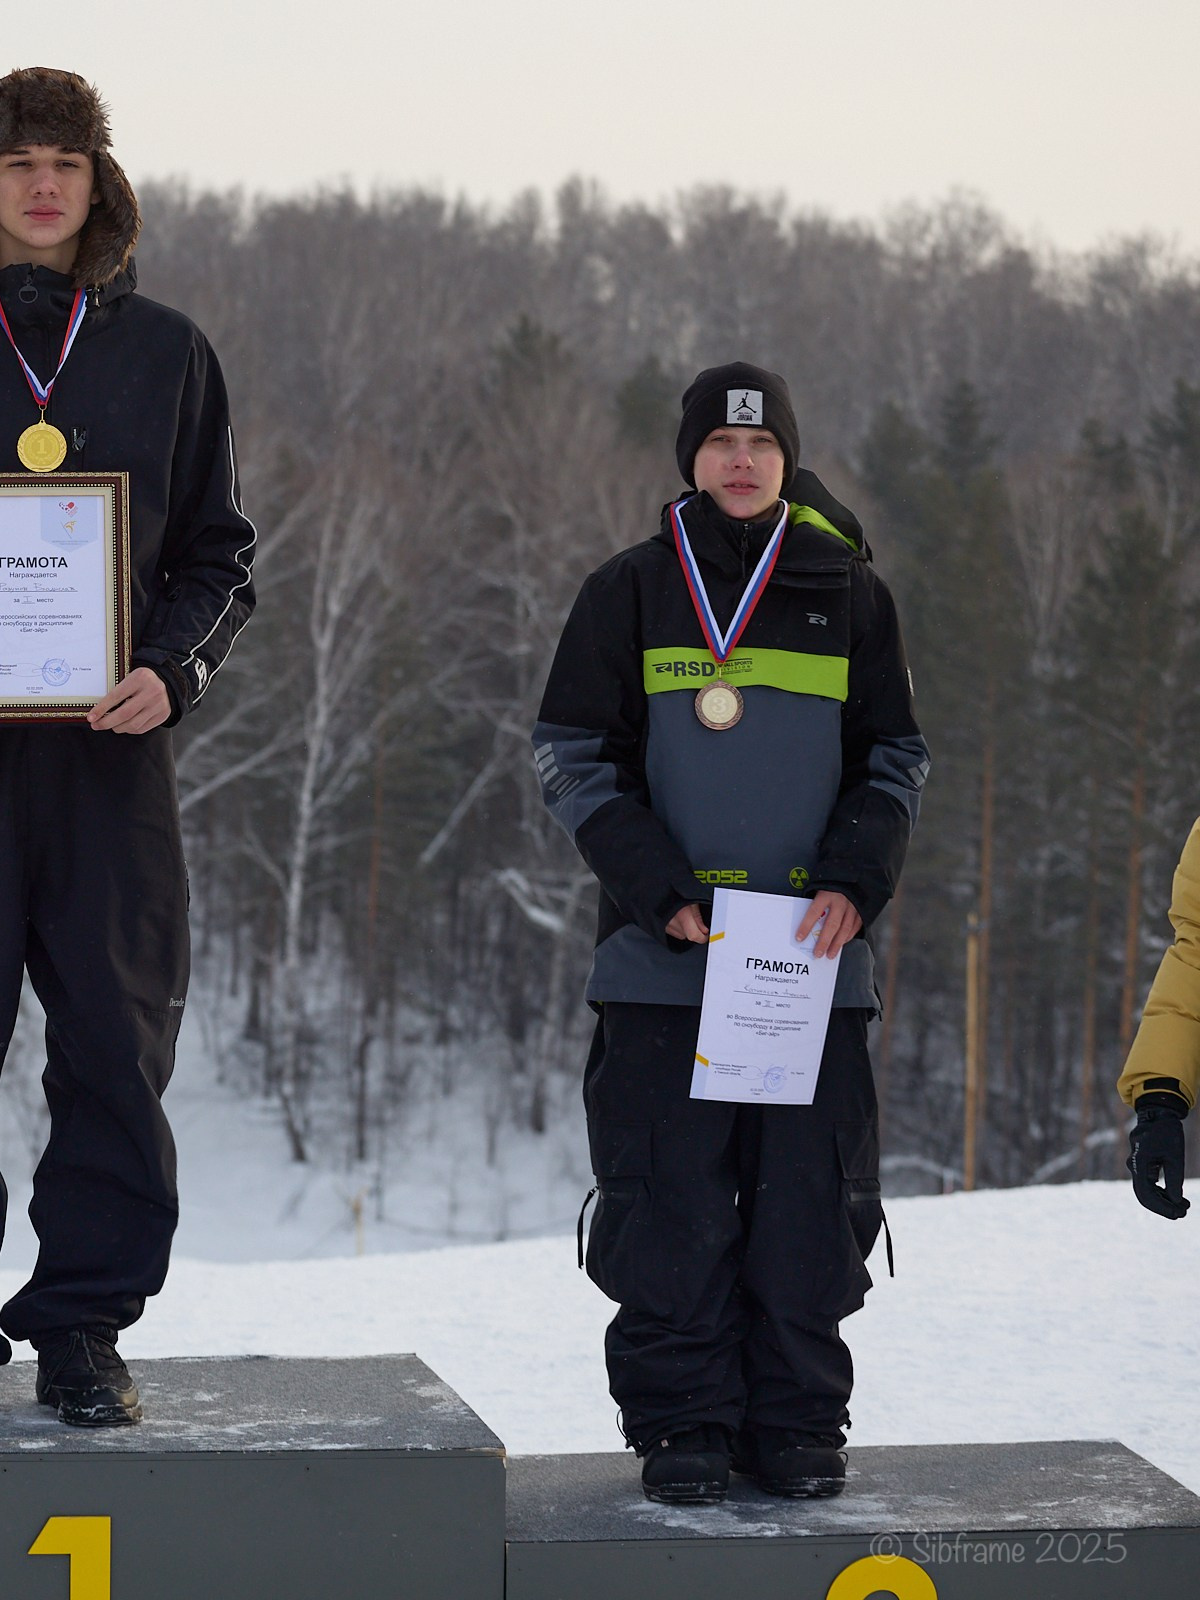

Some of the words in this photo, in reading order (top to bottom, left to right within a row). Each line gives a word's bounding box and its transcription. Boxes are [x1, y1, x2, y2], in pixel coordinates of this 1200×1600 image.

[37, 438, 47, 454] 1
[674, 661, 716, 677] RSD
[711, 696, 727, 713] 3
[693, 870, 748, 884] 2052
[746, 957, 810, 976] ГРАМОТА
[754, 974, 799, 984] Награждается
[734, 1014, 773, 1024] Всероссийских
[741, 1022, 768, 1030] сноуборду
[28, 1515, 111, 1600] 1
